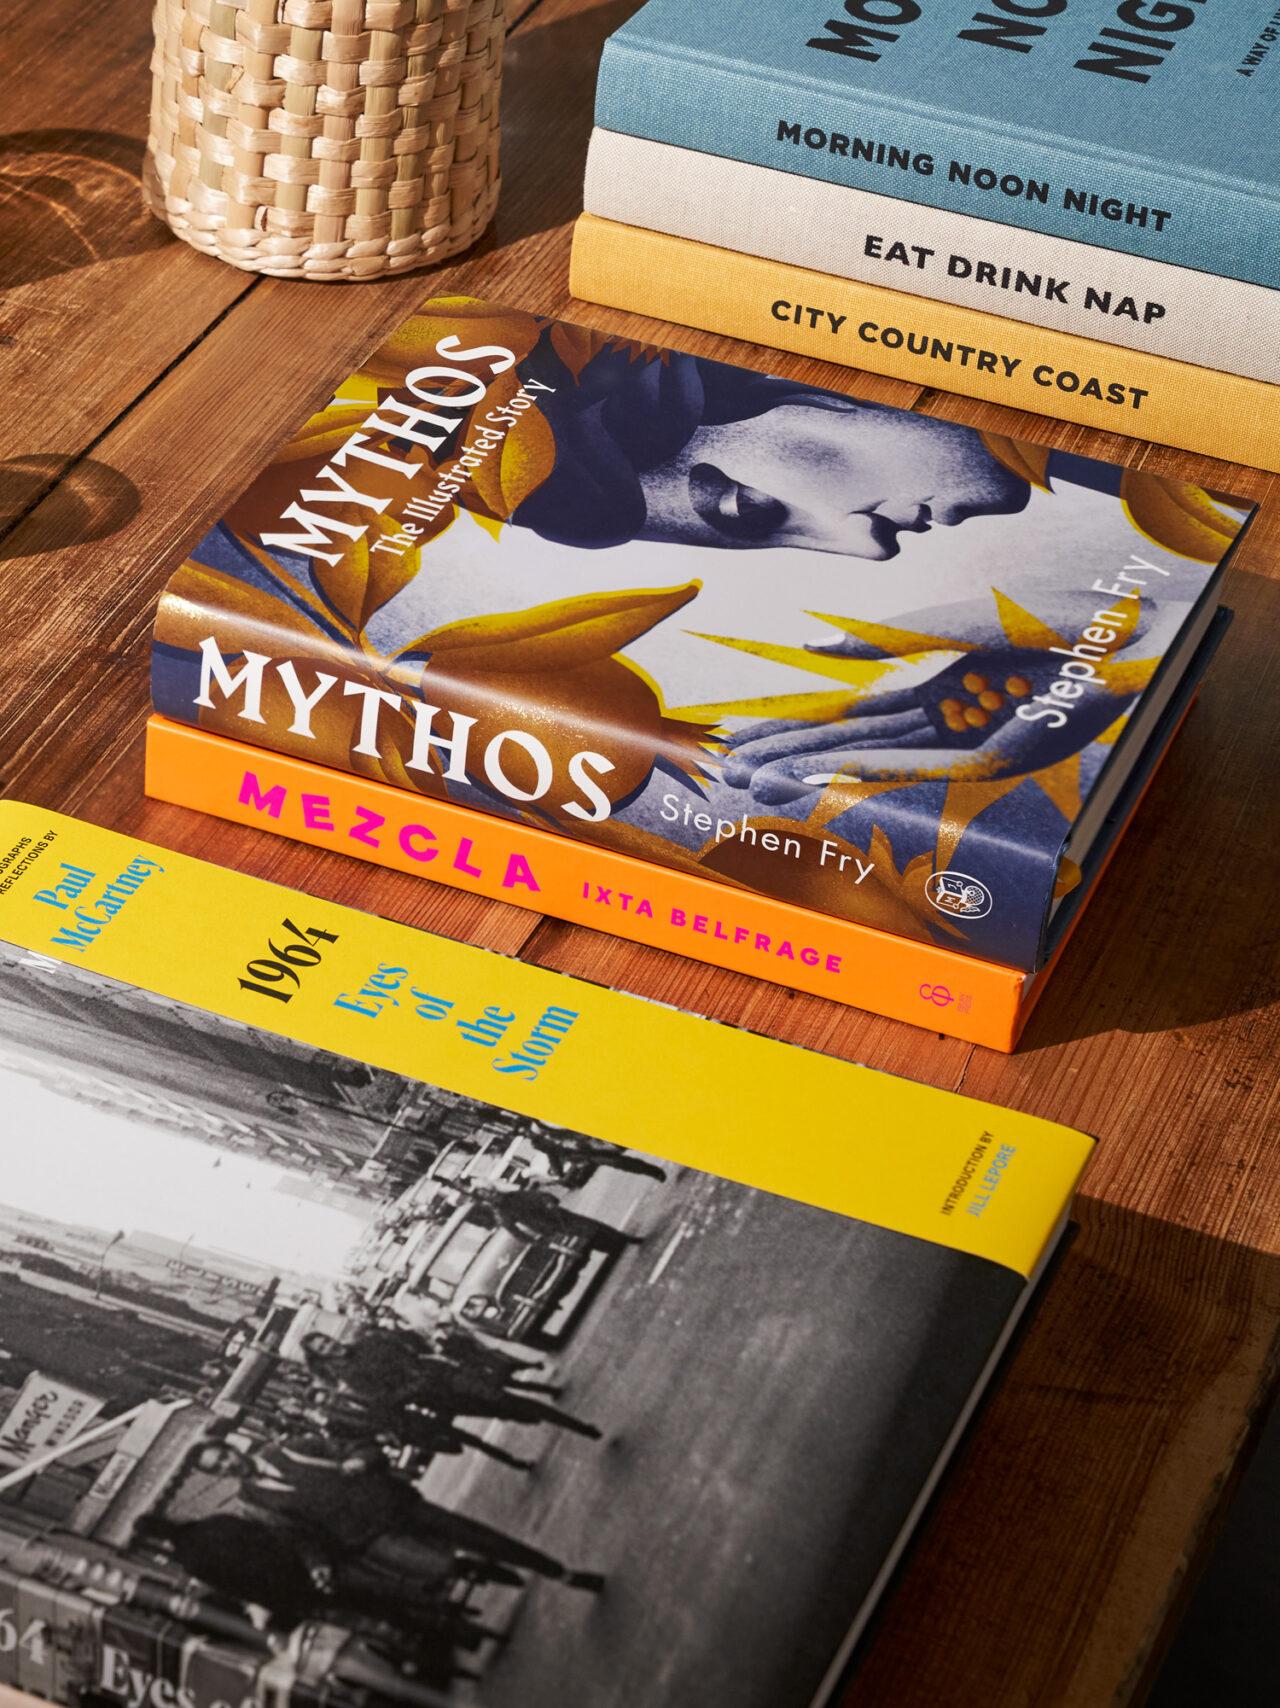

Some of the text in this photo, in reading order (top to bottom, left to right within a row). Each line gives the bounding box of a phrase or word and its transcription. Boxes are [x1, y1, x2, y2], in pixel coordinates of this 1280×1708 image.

[1236, 68, 1255, 77] A
[1241, 42, 1270, 66] WAY
[776, 119, 1172, 232] MORNING NOON NIGHT
[864, 234, 1167, 325] EAT DRINK NAP
[771, 300, 1150, 411] CITY COUNTRY COAST
[259, 333, 517, 567] MYTHOS
[369, 377, 557, 557] The Illustrated Story
[1015, 554, 1170, 729] Stephen Fry
[192, 635, 617, 823] MYTHOS
[43, 829, 59, 843] BY
[237, 770, 843, 974] MEZCLA IXTA BELFRAGE
[659, 793, 875, 885] Stephen Fry
[32, 862, 96, 911] Paul
[50, 854, 165, 952] McCartney
[237, 917, 340, 1004] 1964
[332, 962, 410, 1019] Eyes
[410, 986, 455, 1021] of
[456, 1005, 516, 1048] the
[491, 1004, 580, 1081] Storm
[940, 1130, 994, 1216] INTRODUCTION BY
[966, 1143, 1016, 1218] JILL LEPORE
[100, 1644, 196, 1708] Eyes
